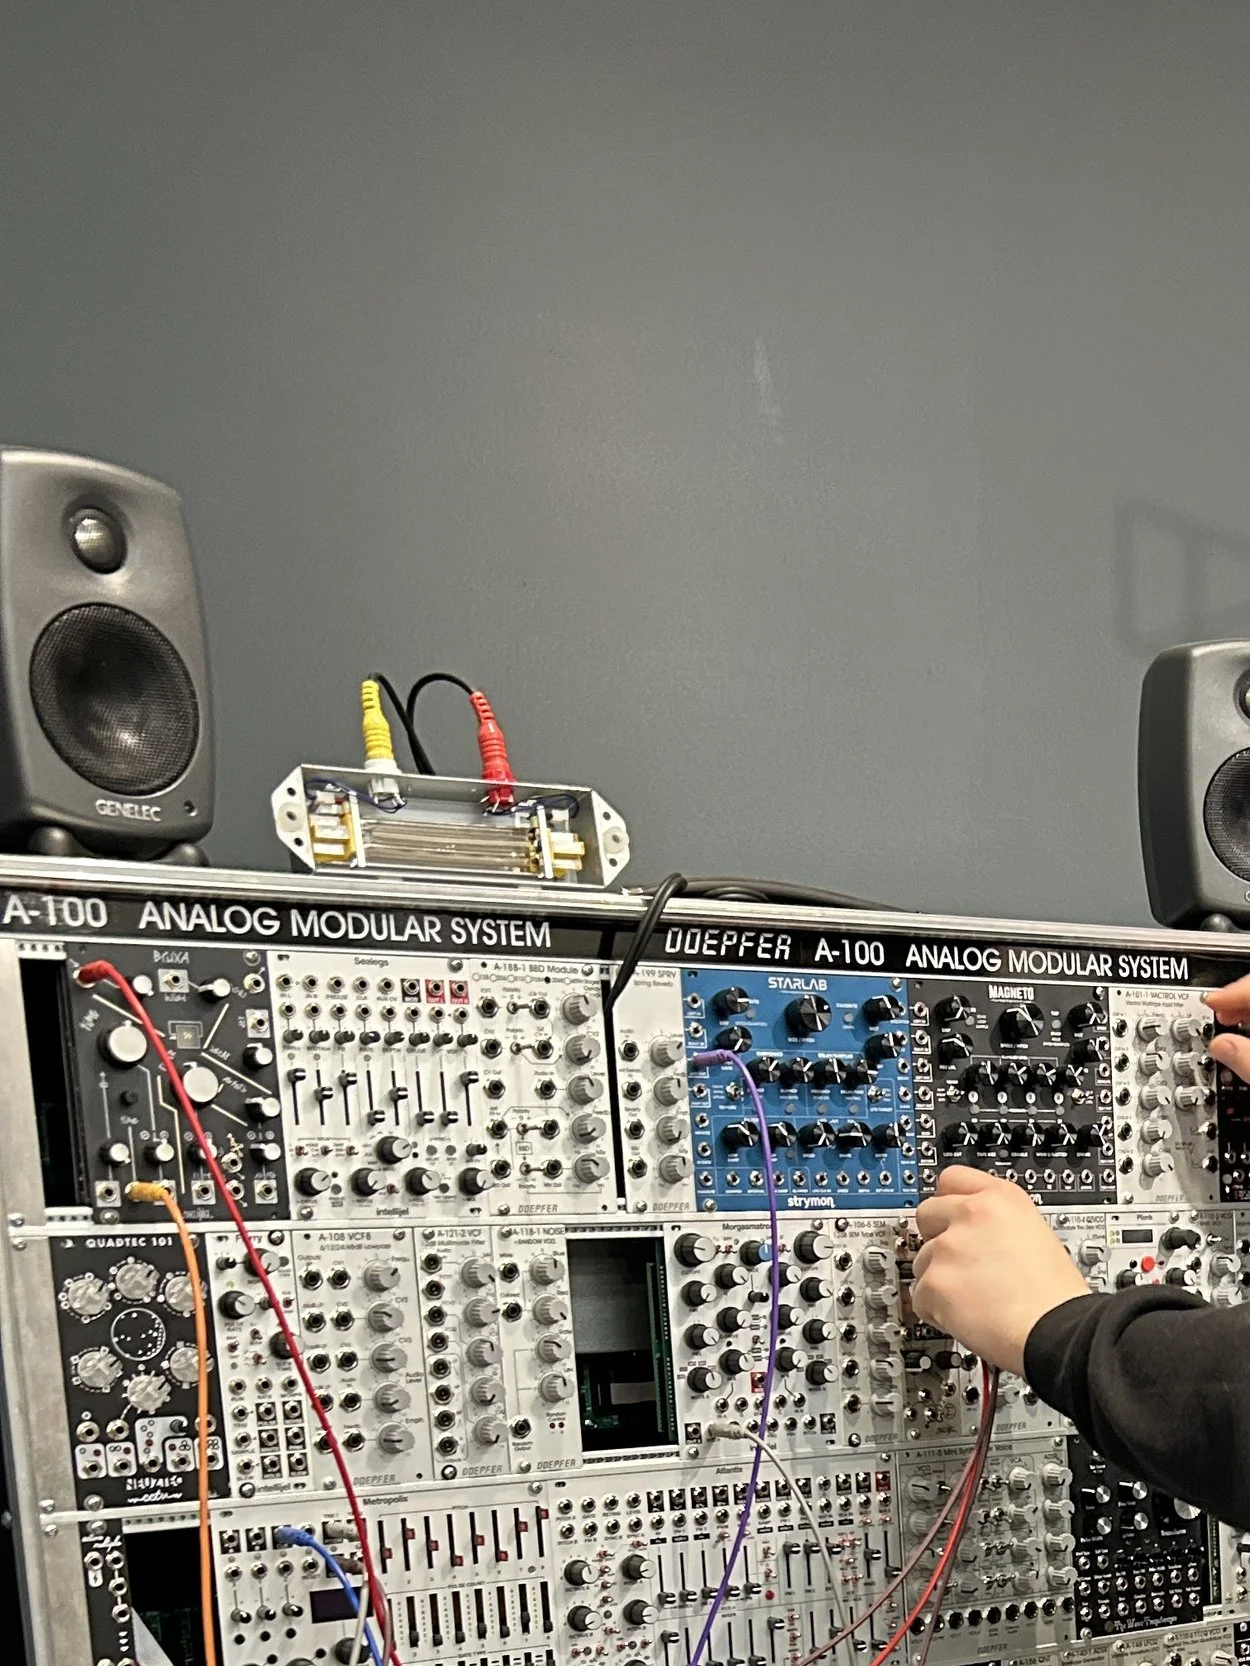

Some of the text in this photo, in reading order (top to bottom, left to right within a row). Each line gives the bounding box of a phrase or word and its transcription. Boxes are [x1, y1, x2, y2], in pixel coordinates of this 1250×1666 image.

[95, 799, 161, 823] GENELEC
[2, 897, 552, 949] A-100 ANALOG MODULAR SYSTEM
[664, 926, 1189, 981] DOEPFER A-100 ANALOG MODULAR SYSTEM
[547, 966, 578, 975] Module
[767, 976, 828, 992] STARLAB
[988, 984, 1035, 1001] MAGNETO
[1178, 993, 1190, 1001] VCF
[652, 1201, 690, 1212] DOEPFER
[787, 1195, 836, 1210] strymon
[517, 1204, 559, 1214] DOEPFER
[543, 1227, 566, 1236] NOISE
[722, 1222, 771, 1232] Morgasmatro
[318, 1232, 347, 1241] A-108
[467, 1229, 482, 1237] VCF
[86, 1235, 173, 1248] QUADTEC 101
[462, 1464, 503, 1476] DOEPFER
[536, 1459, 576, 1470] DOEPFER
[715, 1465, 744, 1475] Atlantix
[352, 1474, 396, 1486] DOEPFER
[363, 1495, 409, 1506] Metropolix
